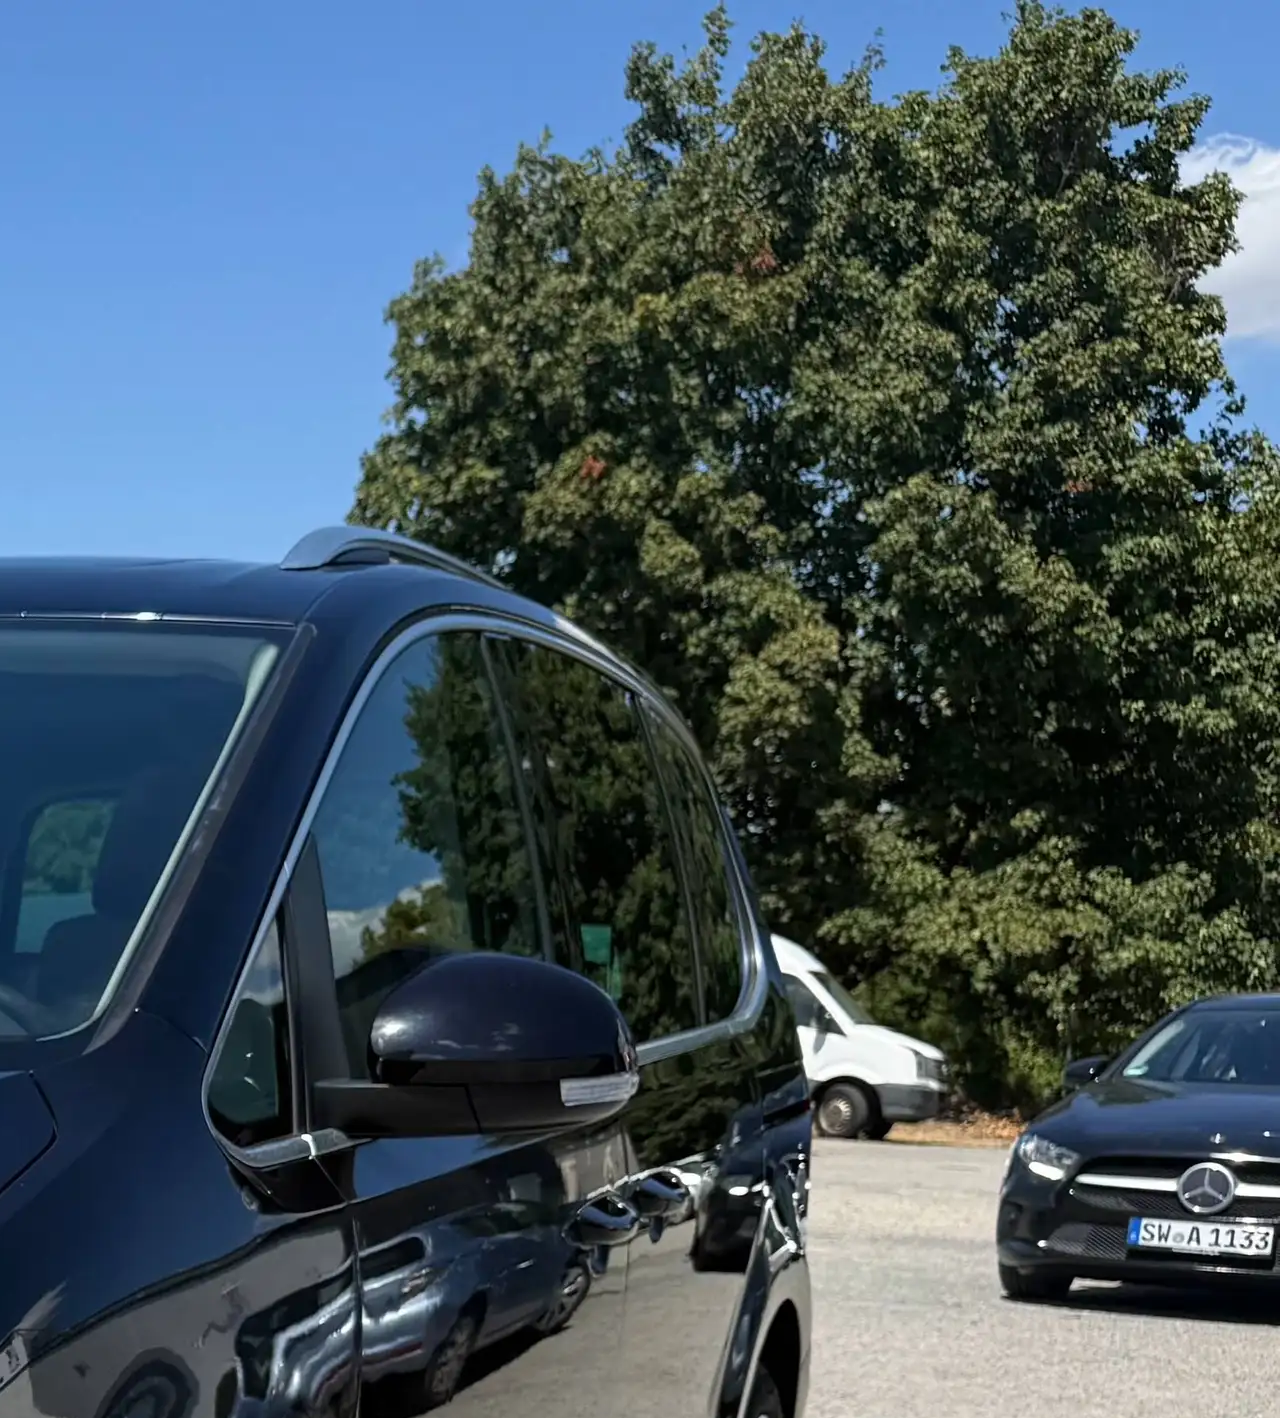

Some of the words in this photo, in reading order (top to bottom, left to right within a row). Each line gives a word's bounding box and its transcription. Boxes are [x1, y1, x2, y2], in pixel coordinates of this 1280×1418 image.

[1141, 1222, 1171, 1243] SW
[1187, 1226, 1201, 1246] A
[1208, 1228, 1270, 1251] 1133
